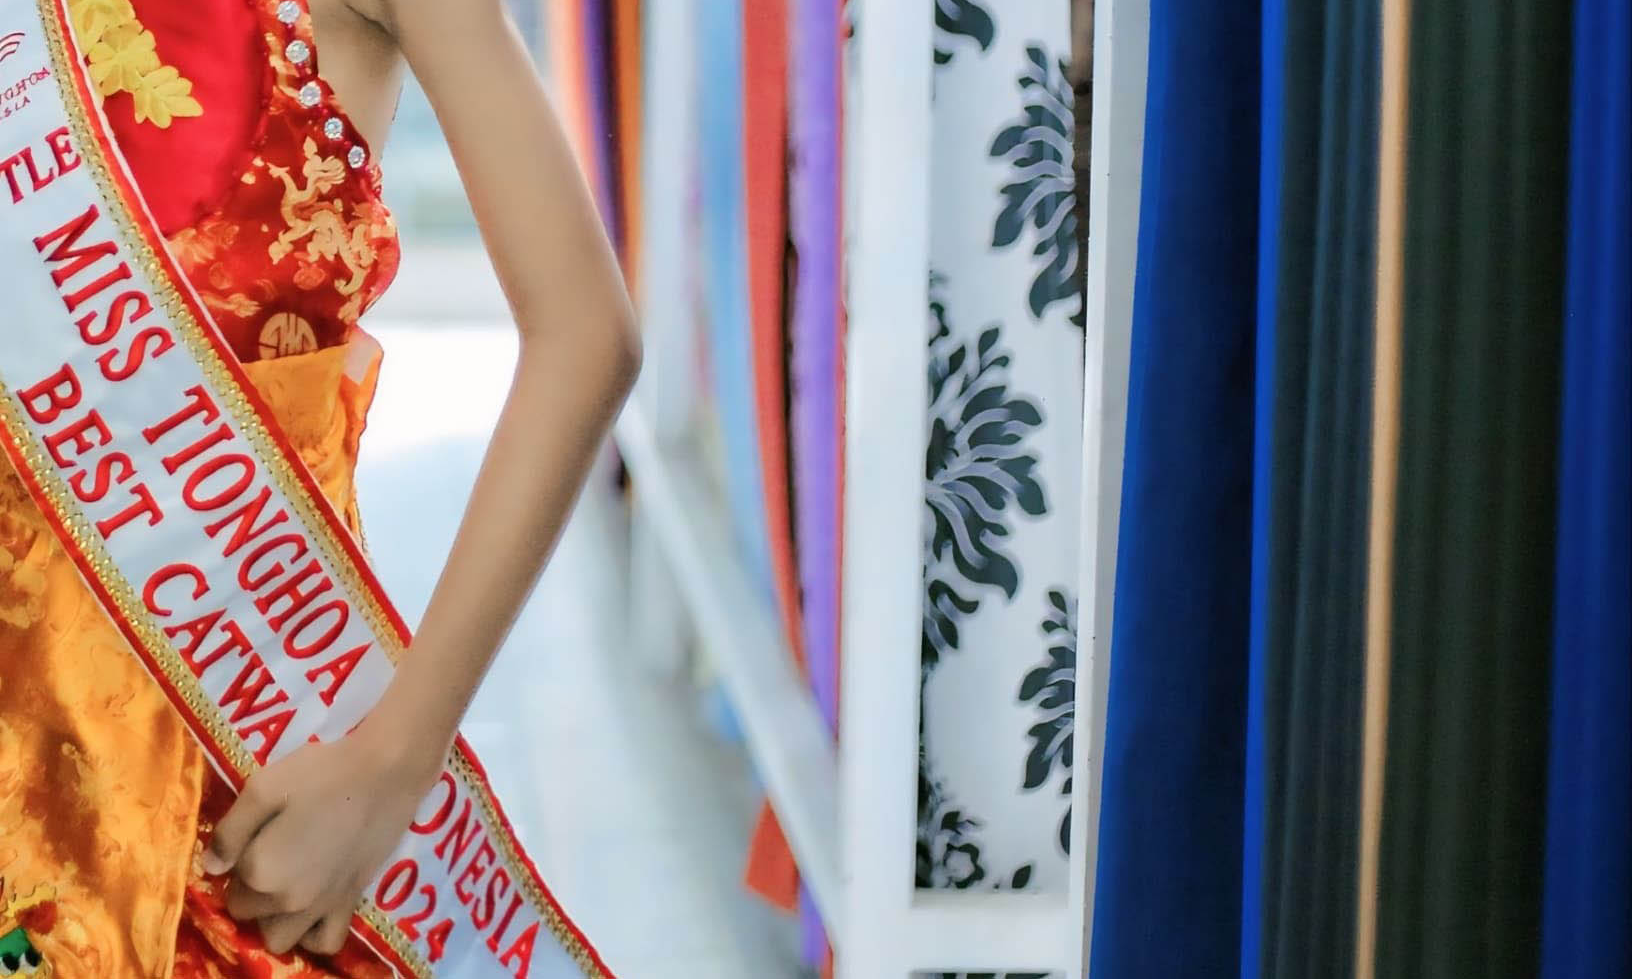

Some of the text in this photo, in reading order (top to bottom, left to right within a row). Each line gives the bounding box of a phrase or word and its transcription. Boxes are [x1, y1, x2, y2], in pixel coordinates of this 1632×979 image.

[16, 362, 455, 964] BEST CATWA 024
[32, 203, 541, 979] MISS TIONGHOA ONESIA
